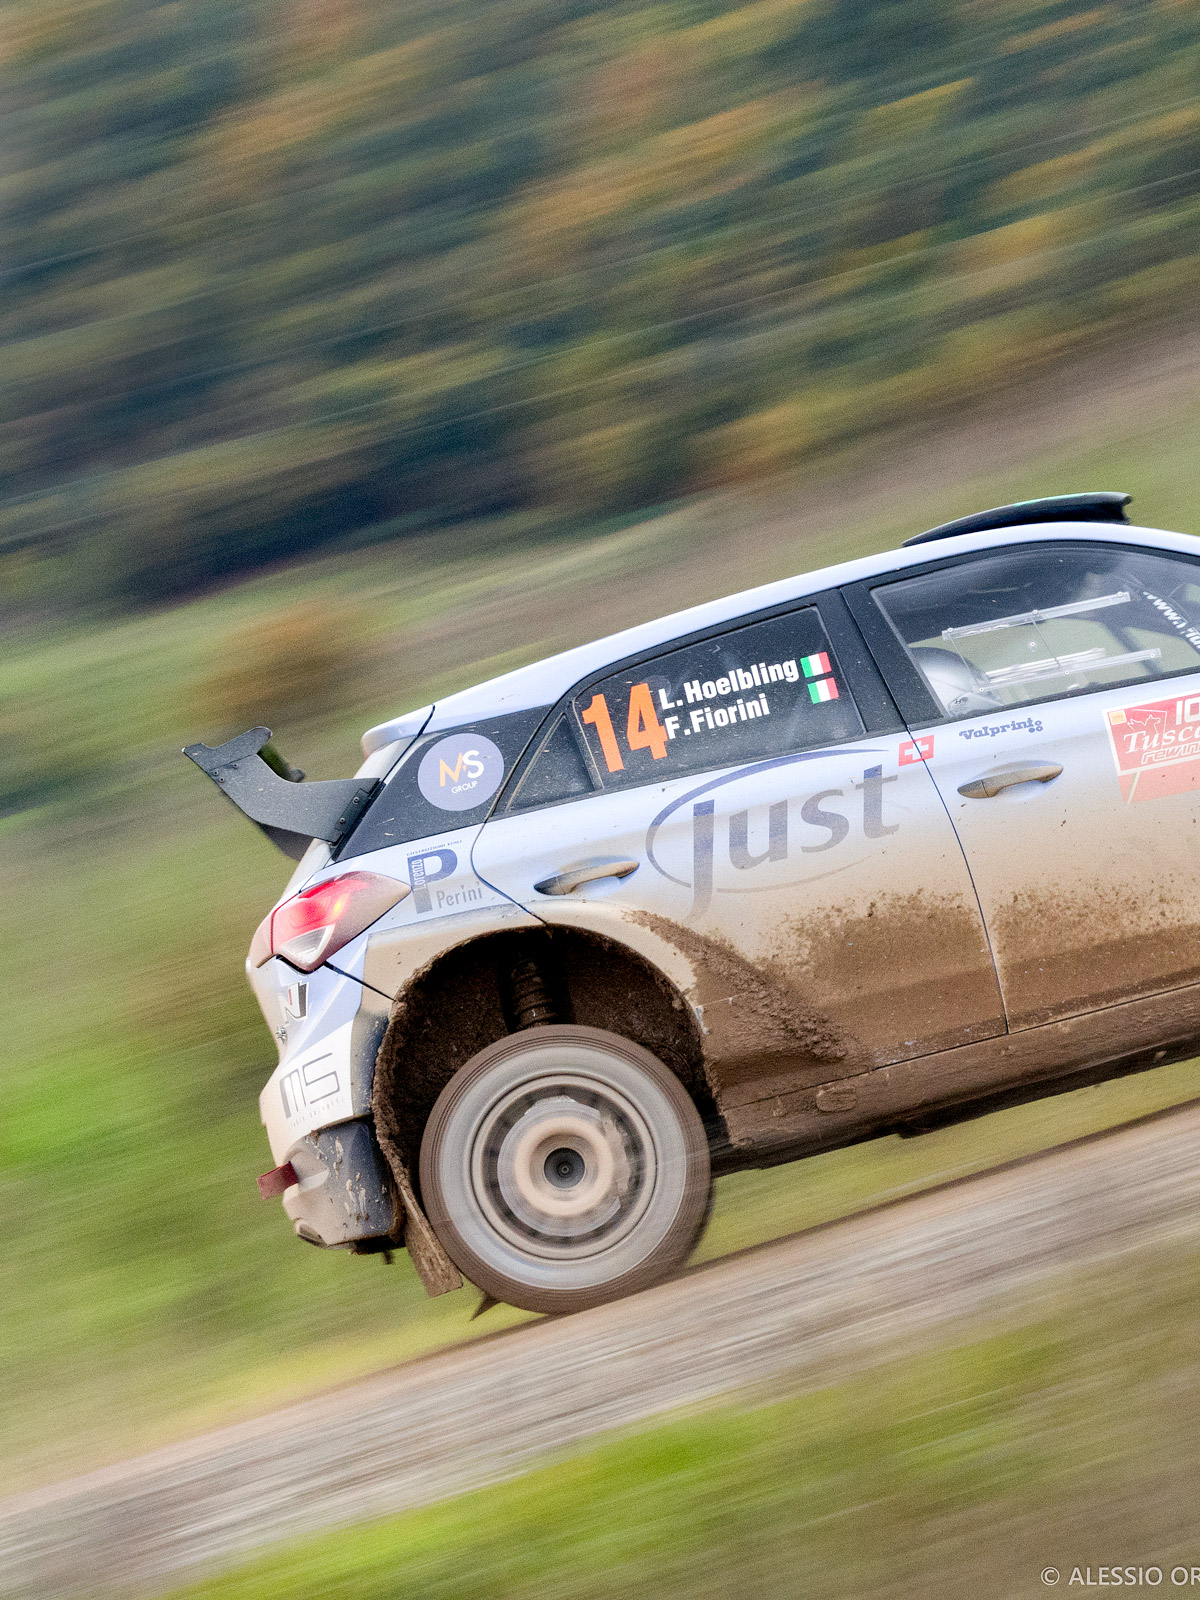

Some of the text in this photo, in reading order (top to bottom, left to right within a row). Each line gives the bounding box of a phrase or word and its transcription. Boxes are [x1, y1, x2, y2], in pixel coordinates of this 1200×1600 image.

[684, 659, 800, 697] Hoelbling
[582, 682, 669, 773] 14
[689, 694, 770, 734] Fiorini
[959, 717, 1034, 740] Valprint
[451, 780, 478, 794] GROUP
[685, 764, 900, 924] just
[411, 858, 428, 891] Lorenzo
[436, 880, 483, 909] Perini
